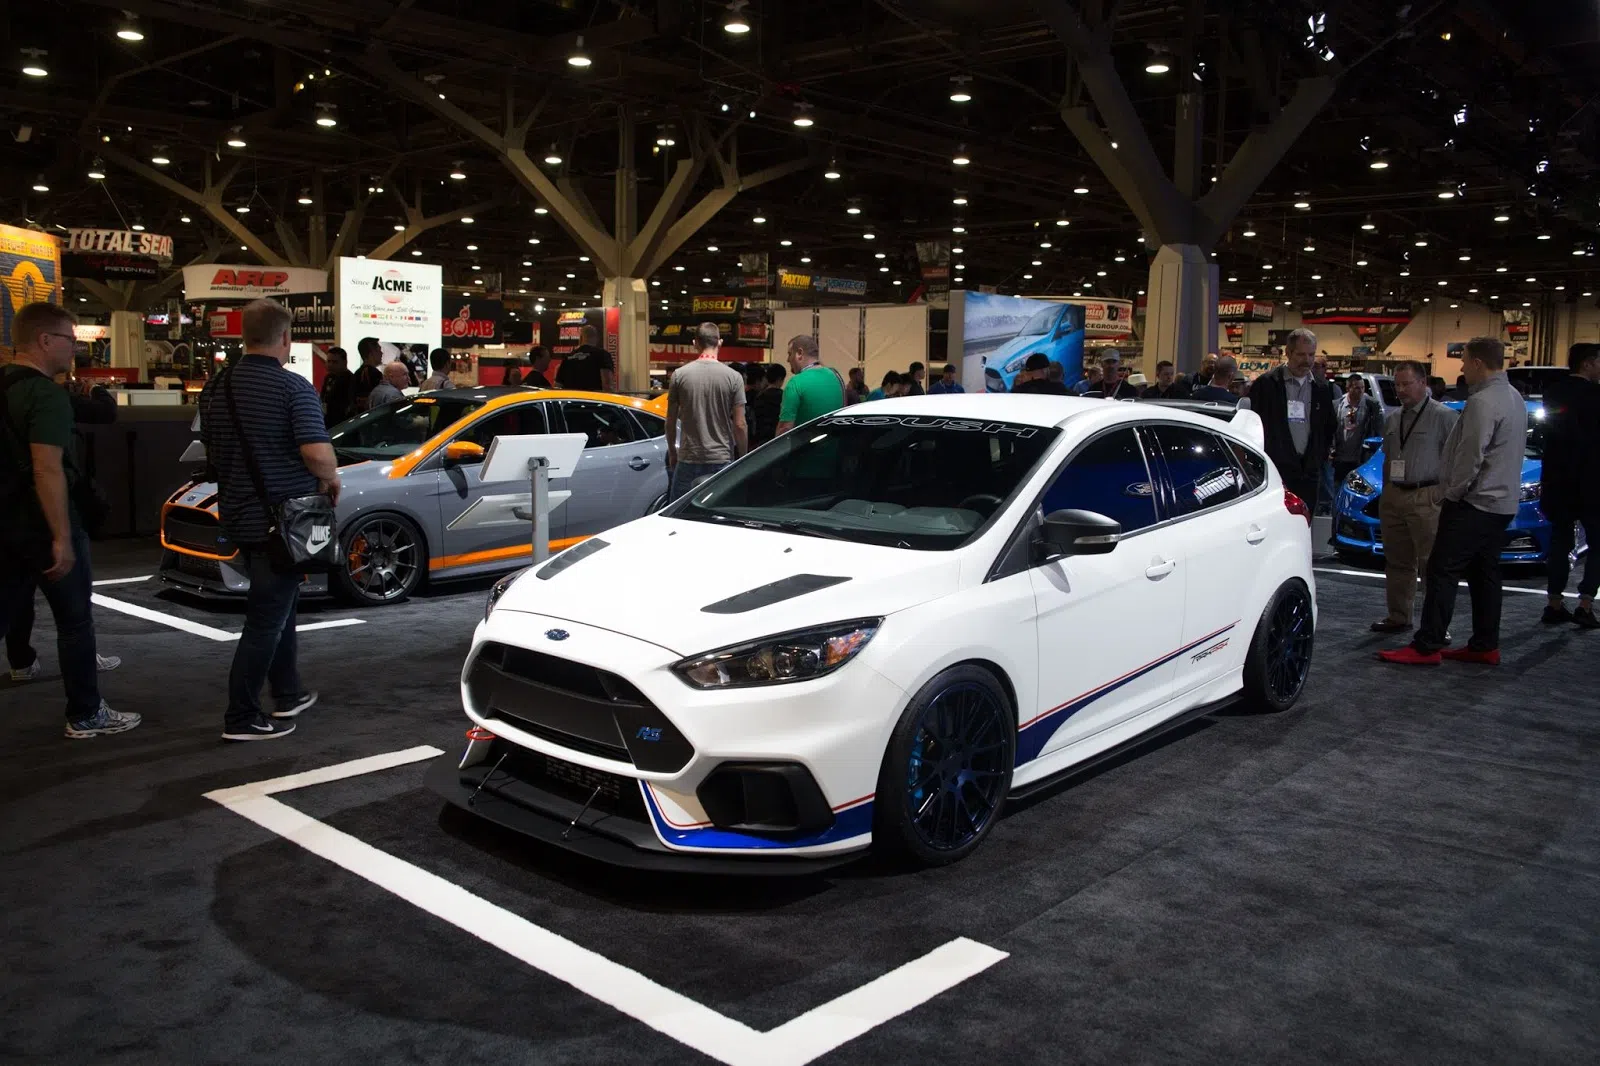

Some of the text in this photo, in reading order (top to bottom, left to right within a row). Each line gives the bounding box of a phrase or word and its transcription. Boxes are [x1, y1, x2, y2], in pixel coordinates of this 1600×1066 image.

[68, 229, 134, 253] TOTAL
[211, 269, 289, 287] ARP
[372, 276, 413, 292] ACME
[781, 272, 811, 286] PAXTON
[281, 295, 335, 323] ilverlin
[693, 299, 735, 311] RUSSELL
[1218, 303, 1247, 316] MASTER
[442, 317, 496, 338] BOMB
[1085, 322, 1129, 331] CEGROUP.COM
[817, 416, 1039, 439] ROUSH
[311, 525, 331, 541] NIKE
